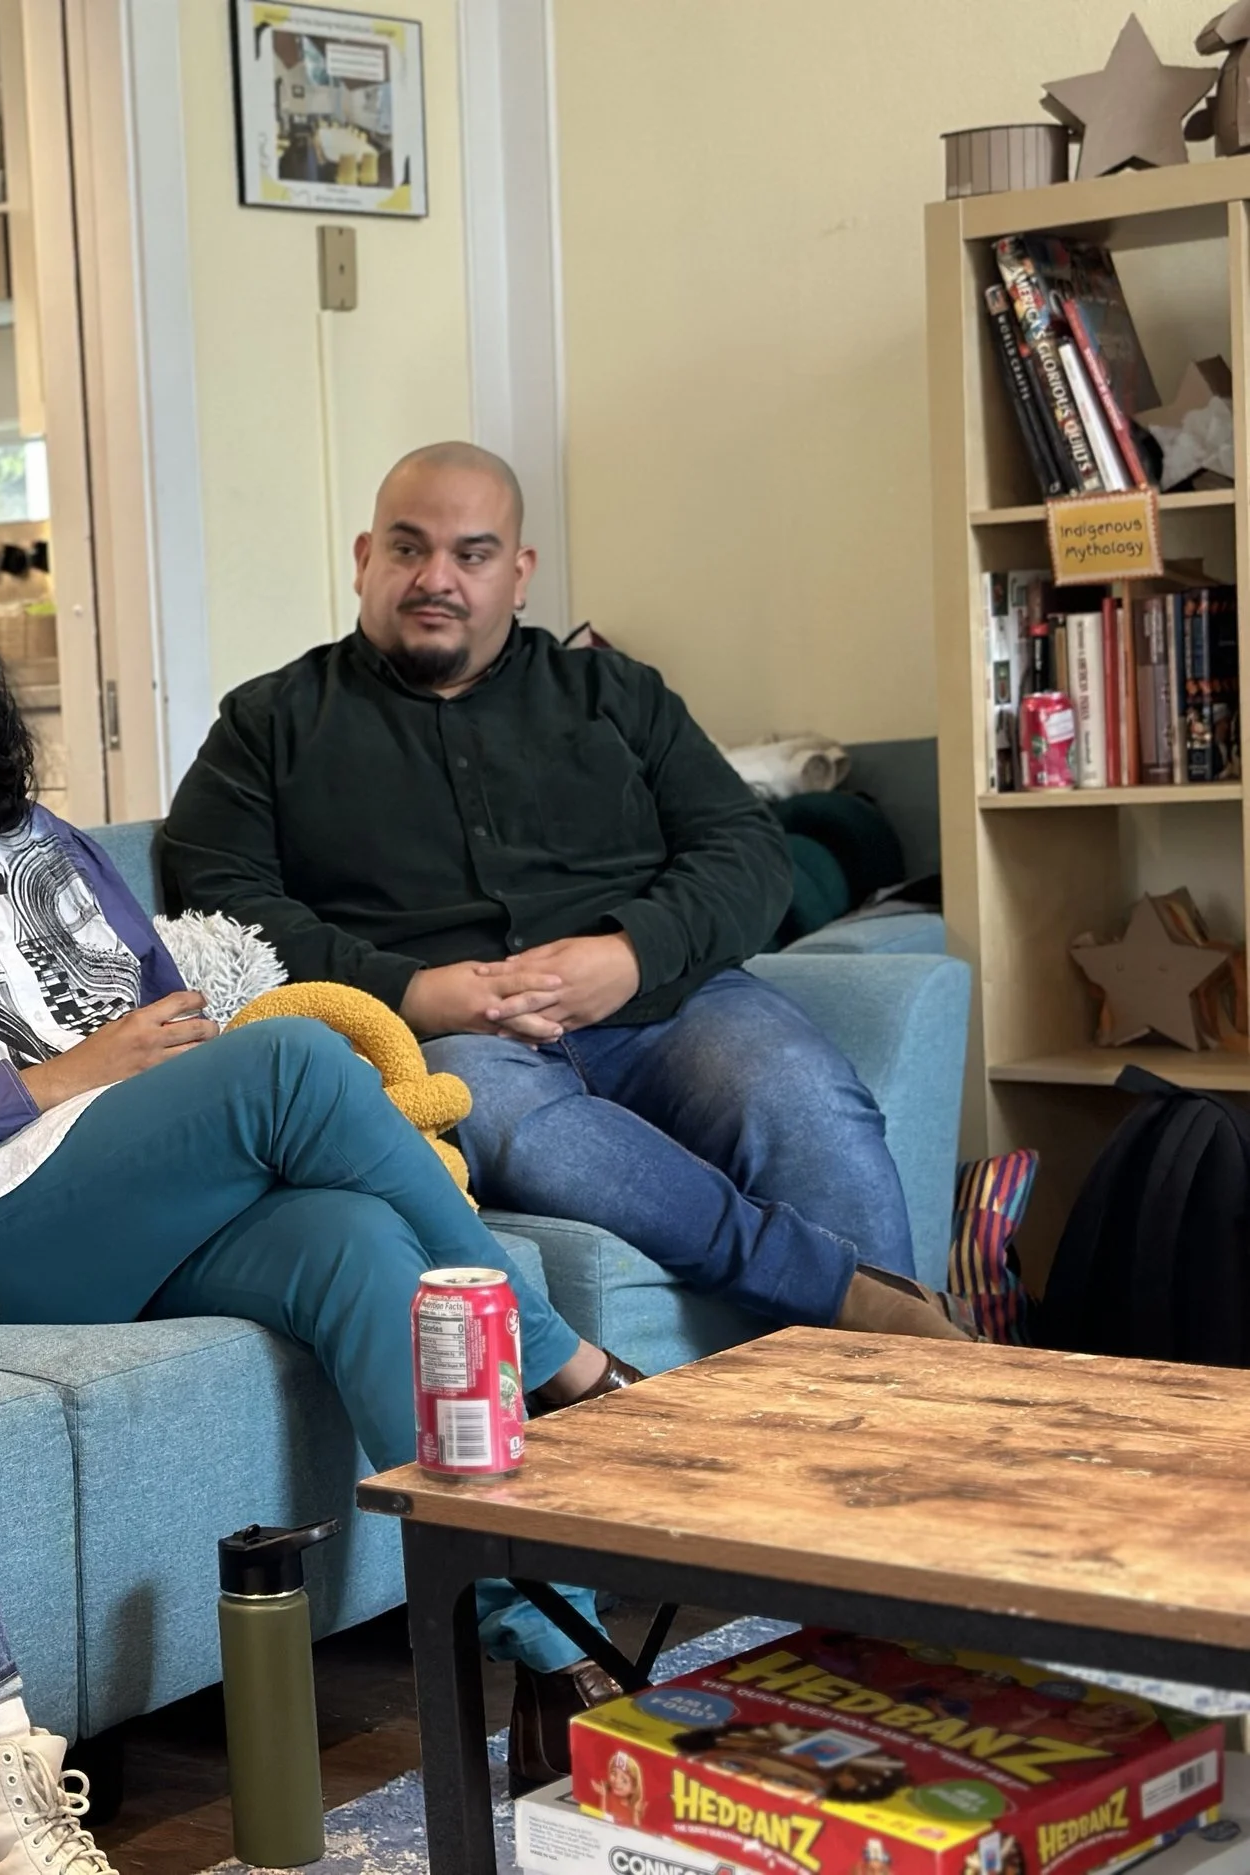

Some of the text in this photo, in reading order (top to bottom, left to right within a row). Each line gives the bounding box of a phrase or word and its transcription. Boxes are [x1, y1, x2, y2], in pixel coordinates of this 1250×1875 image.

[997, 314, 1030, 400] WORLD CRAFTS
[1036, 341, 1072, 417] GLORIOUS
[1064, 420, 1092, 473] QUILTS
[1060, 519, 1143, 541] Indigenous
[1065, 540, 1144, 563] Mythology
[445, 1302, 463, 1310] Facts
[420, 1322, 463, 1333] Calories 0
[651, 1698, 717, 1720] FOOD?
[670, 1697, 701, 1708] AM
[701, 1680, 733, 1692] THE
[736, 1688, 786, 1706] QUICK
[788, 1702, 868, 1731] QUESTION
[868, 1727, 915, 1745] GAME
[719, 1650, 1114, 1784] HEDBANZ
[671, 1770, 823, 1873] HEDBANZ
[1038, 1785, 1129, 1864] HEDBANZ
[613, 1851, 705, 1875] CONN
